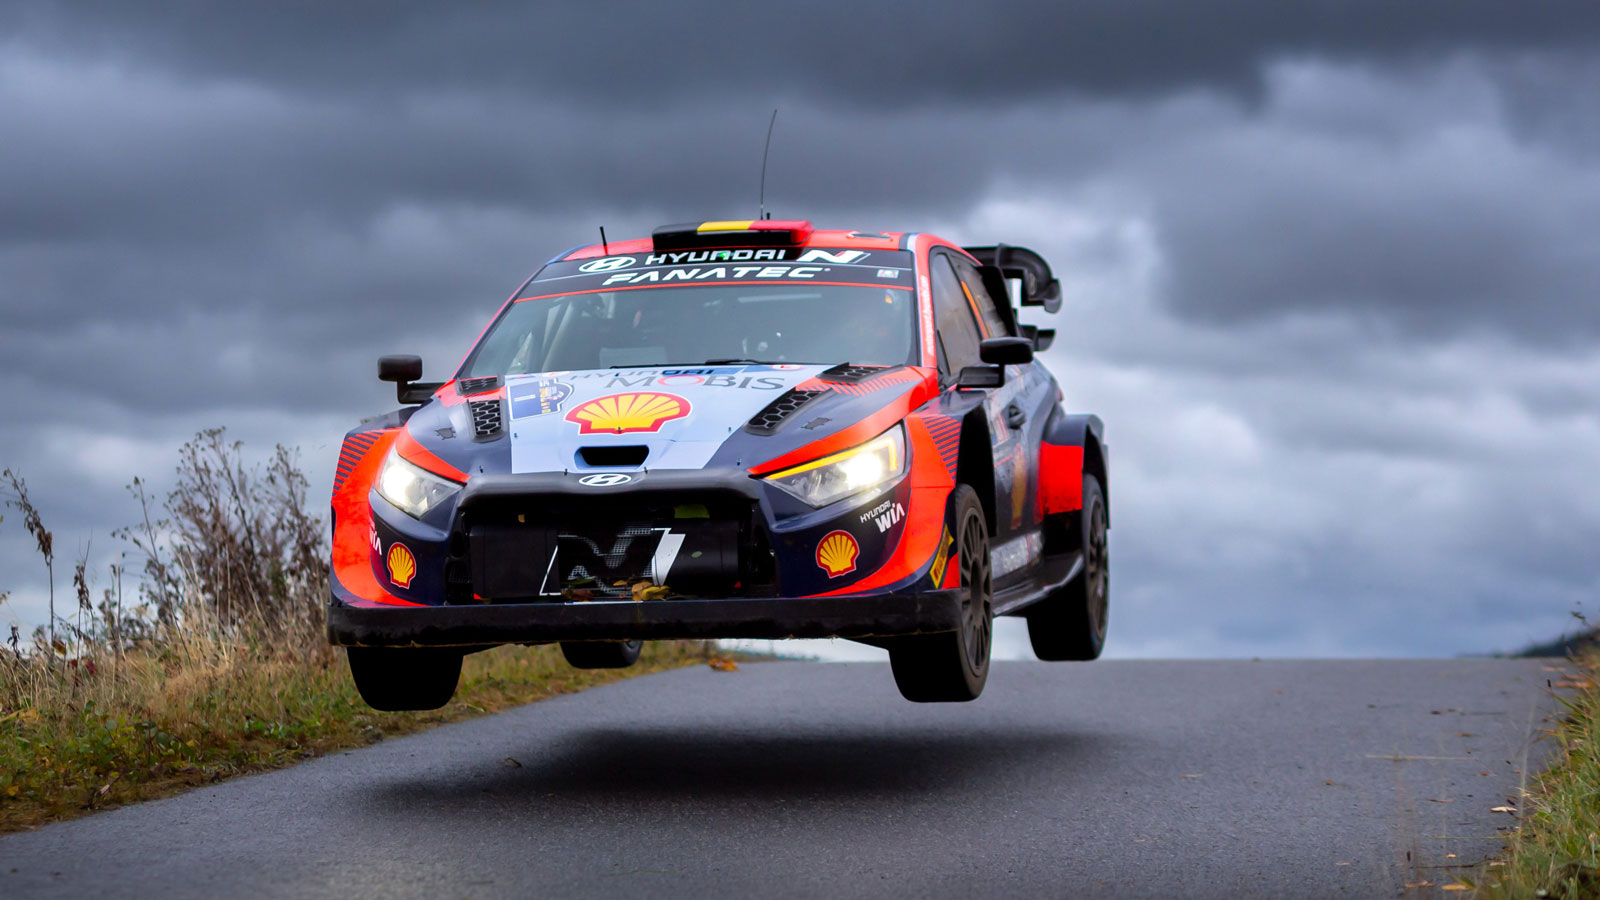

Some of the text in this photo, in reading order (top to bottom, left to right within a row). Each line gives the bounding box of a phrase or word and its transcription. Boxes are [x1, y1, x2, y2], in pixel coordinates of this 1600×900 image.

[645, 249, 787, 265] HYUNDAI
[602, 267, 825, 286] FANATEC
[605, 374, 785, 390] MOBIS
[860, 500, 891, 523] HYUNDAI
